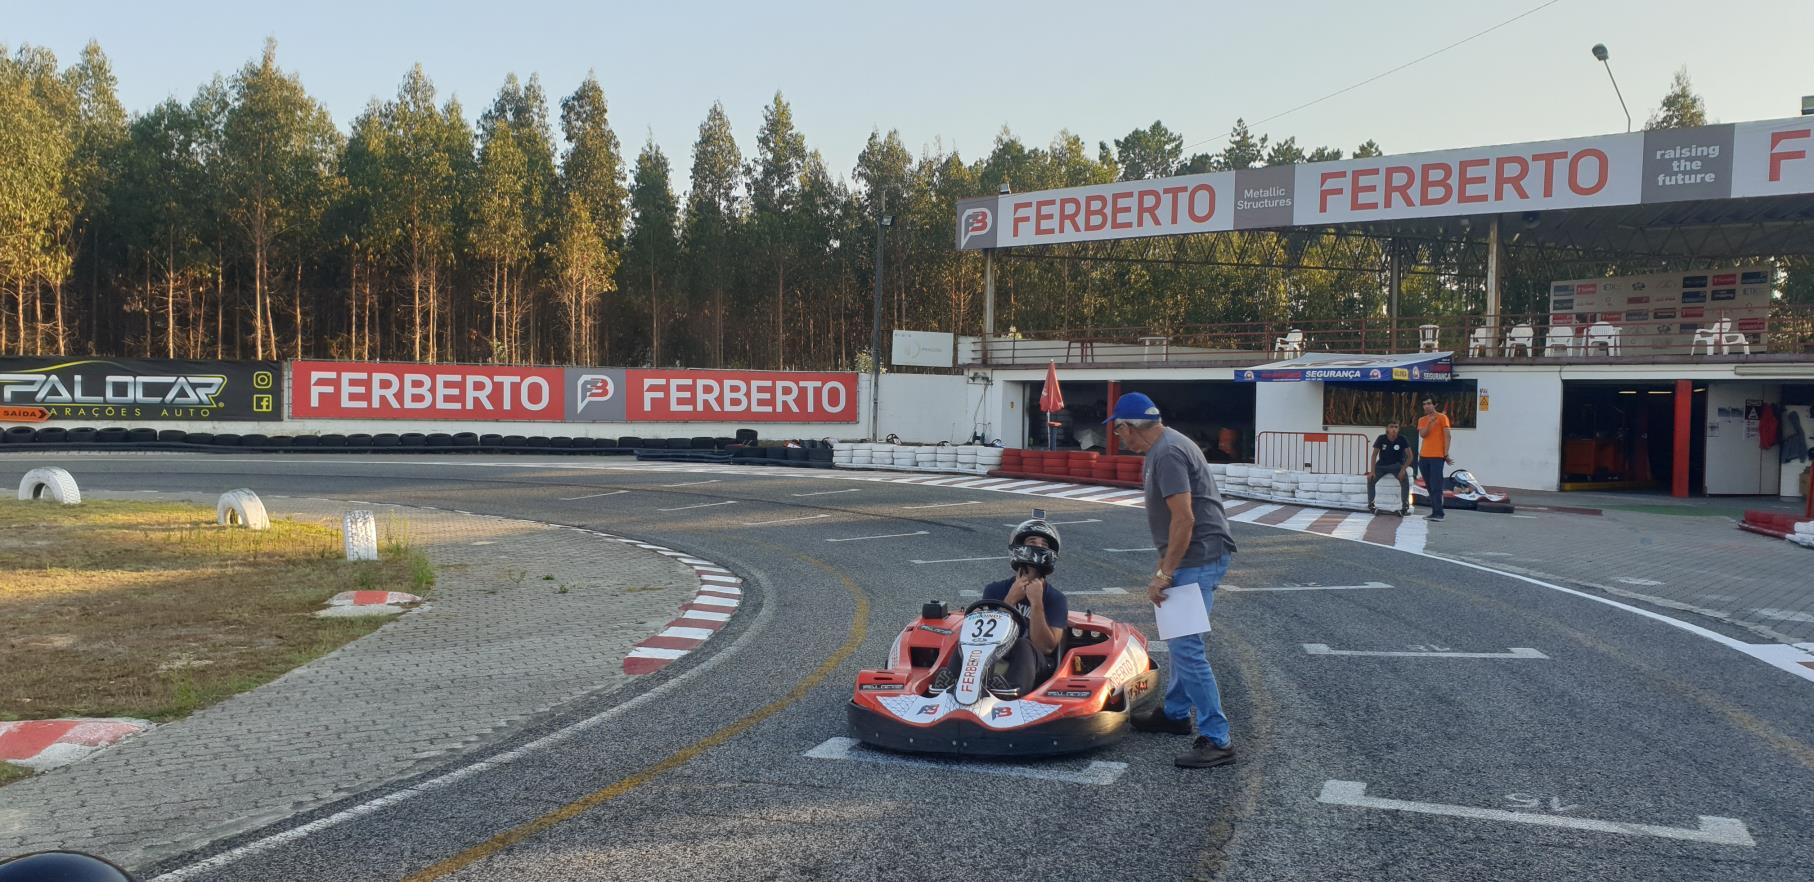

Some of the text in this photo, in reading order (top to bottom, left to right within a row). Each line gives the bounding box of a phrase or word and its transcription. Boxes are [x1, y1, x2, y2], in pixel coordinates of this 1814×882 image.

[1655, 144, 1720, 162] raising
[1672, 157, 1702, 171] the
[1318, 148, 1609, 213] FERBERTO
[1657, 171, 1716, 186] future
[1244, 188, 1285, 198] Metallic
[1013, 183, 1217, 237] FERBERTO
[1237, 198, 1292, 211] Structures
[1305, 370, 1361, 379] SEGURANÇA
[310, 371, 550, 411] FERBERTO
[643, 378, 846, 413] FERBERTO
[161, 408, 210, 418] AUTO
[971, 618, 998, 638] 32
[961, 650, 982, 692] FERBERTO
